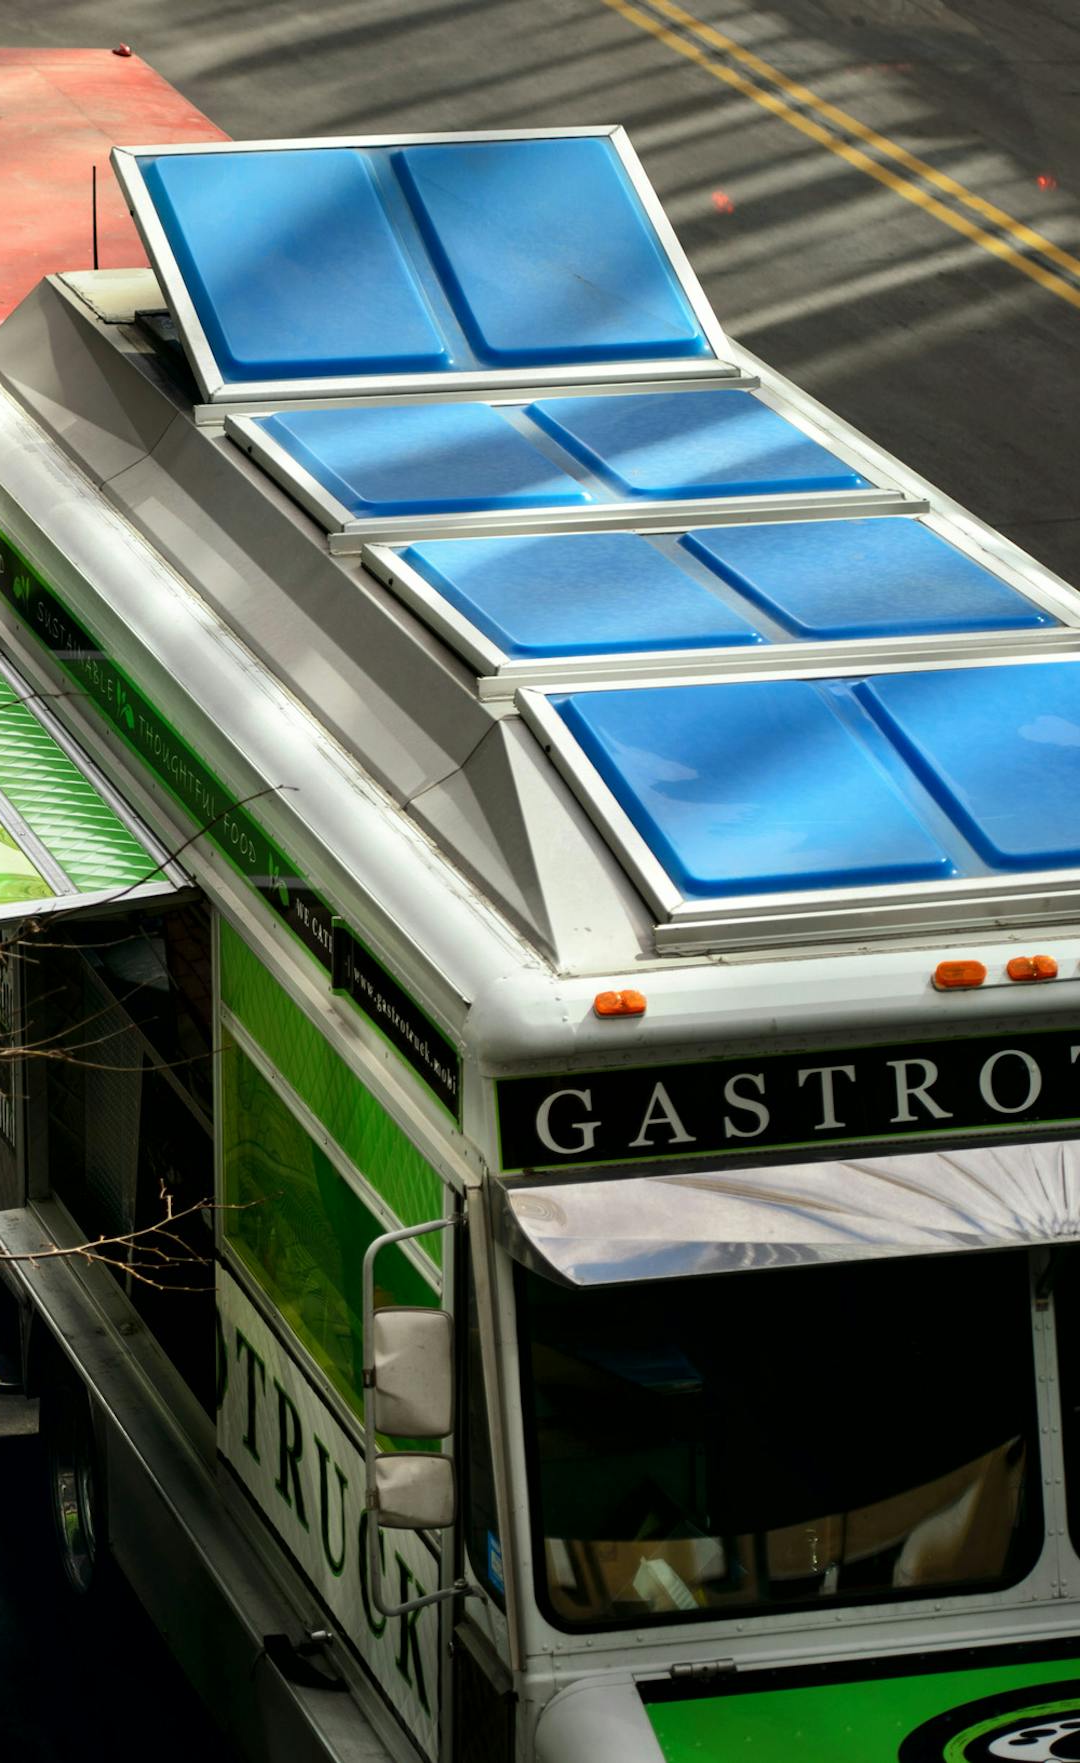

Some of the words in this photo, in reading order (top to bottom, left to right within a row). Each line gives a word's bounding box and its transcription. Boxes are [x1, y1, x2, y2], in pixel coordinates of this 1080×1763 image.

[36, 601, 113, 701] SUSTAINABLE
[138, 715, 216, 821] THOUGHTFUL
[223, 812, 257, 863] FOOD
[296, 897, 310, 928] WE
[353, 967, 456, 1095] www.gastrotruck.mobi
[535, 1045, 1080, 1155] GASTRO
